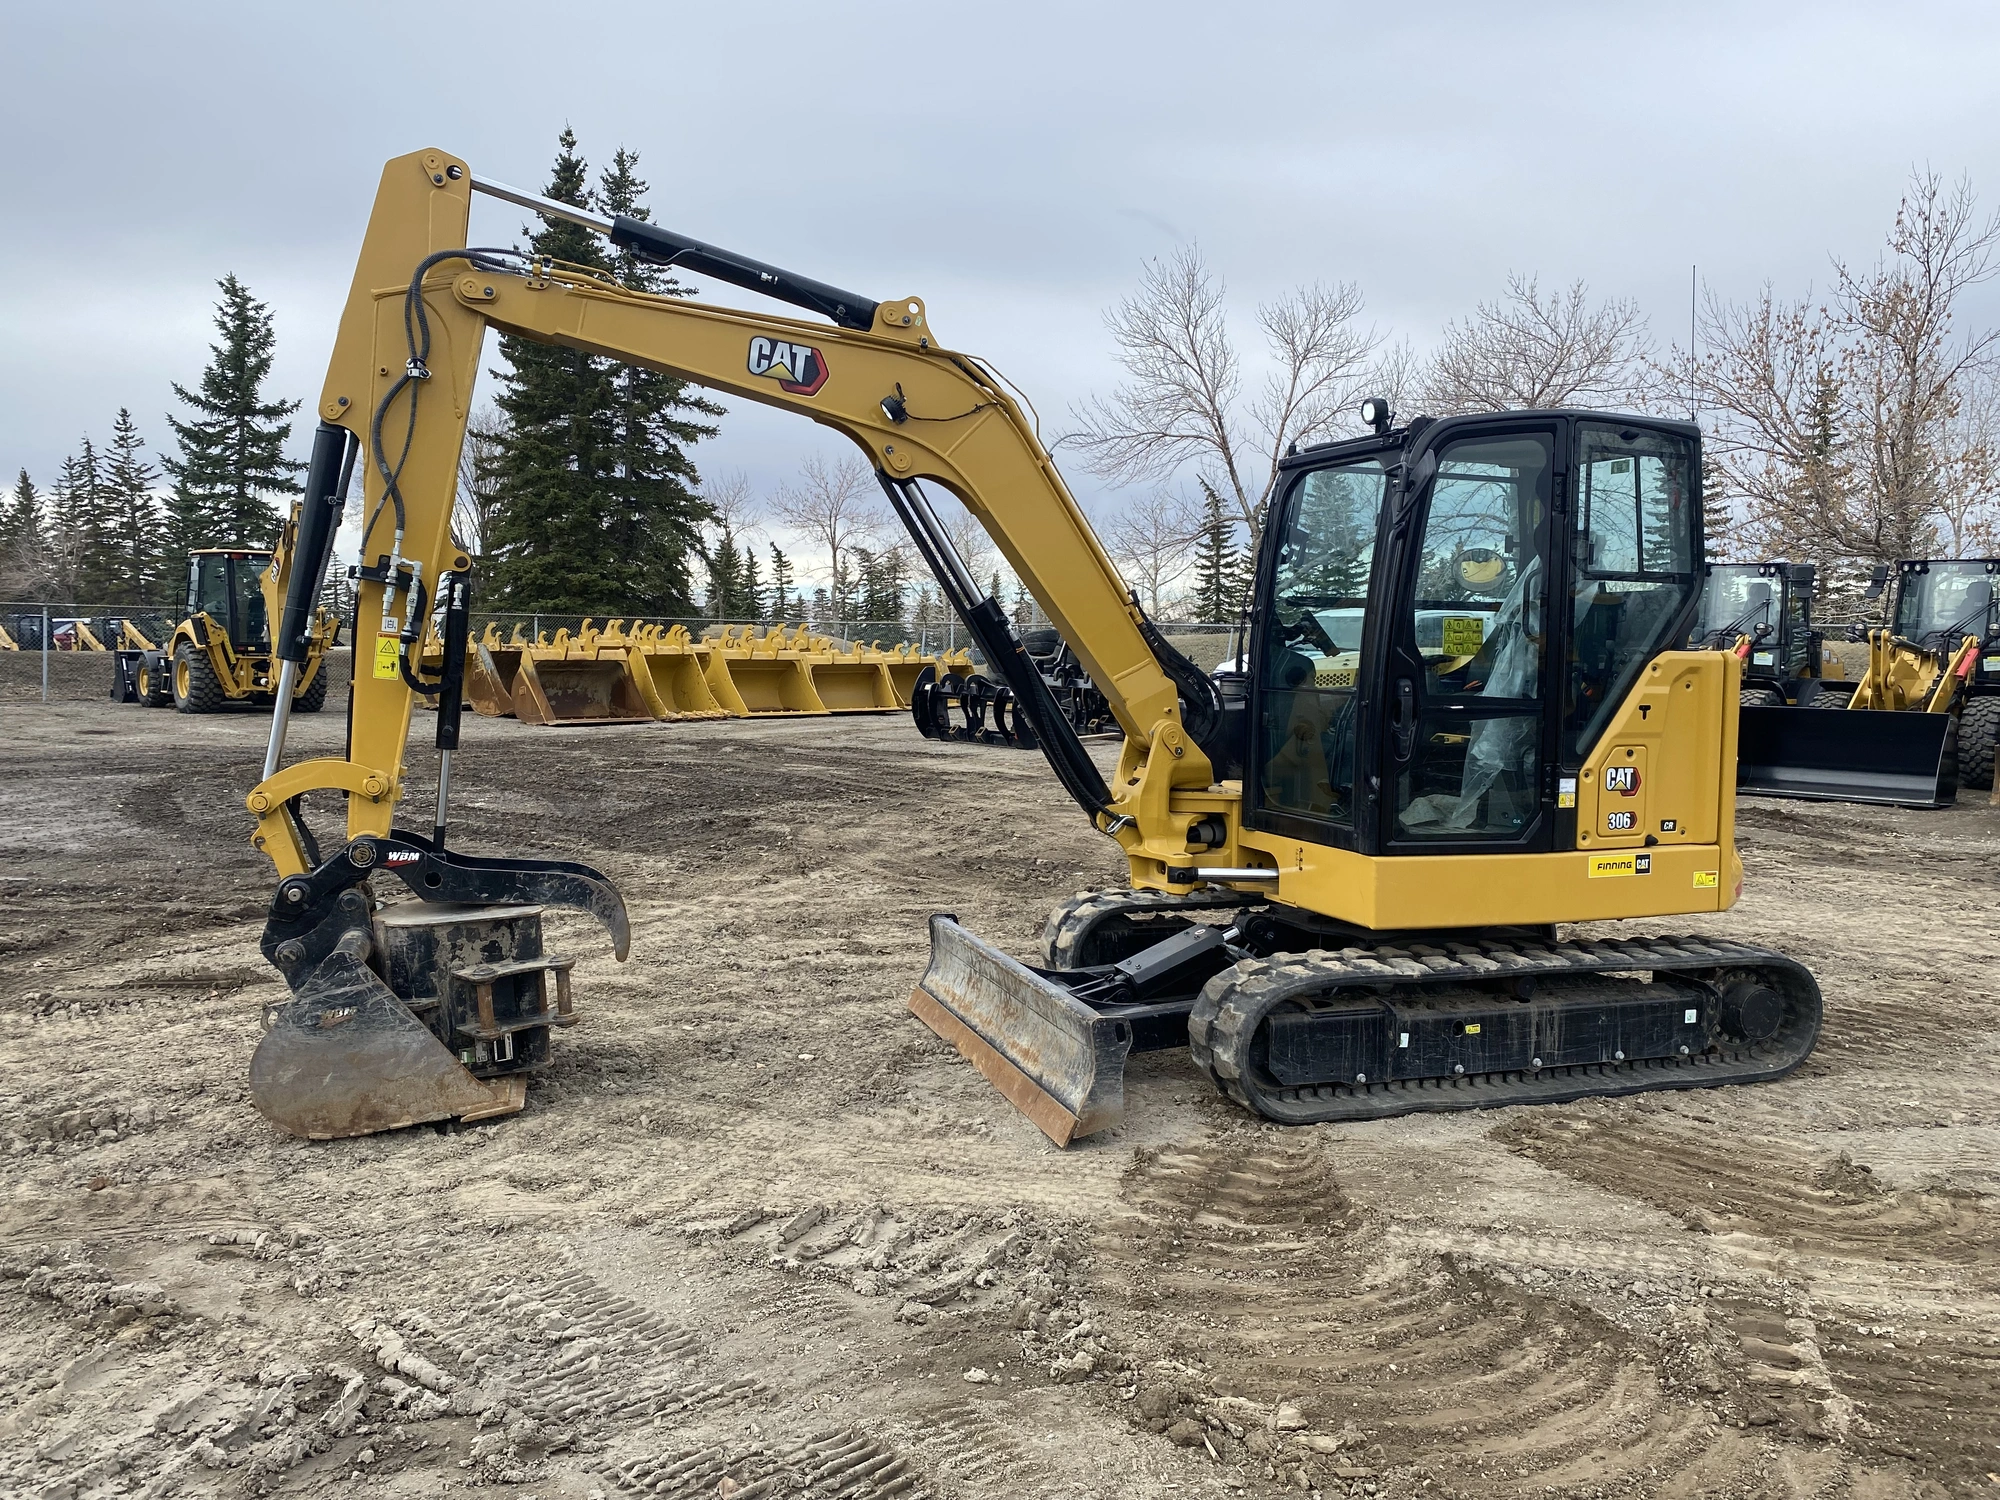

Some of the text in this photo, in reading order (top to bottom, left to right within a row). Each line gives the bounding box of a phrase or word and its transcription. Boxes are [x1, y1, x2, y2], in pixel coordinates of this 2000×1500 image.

[748, 336, 812, 383] CAT
[1606, 767, 1634, 791] CAT
[1608, 812, 1631, 830] 306
[1663, 821, 1674, 830] CR
[388, 851, 420, 861] WBM
[1597, 859, 1649, 871] FINNING CAT
